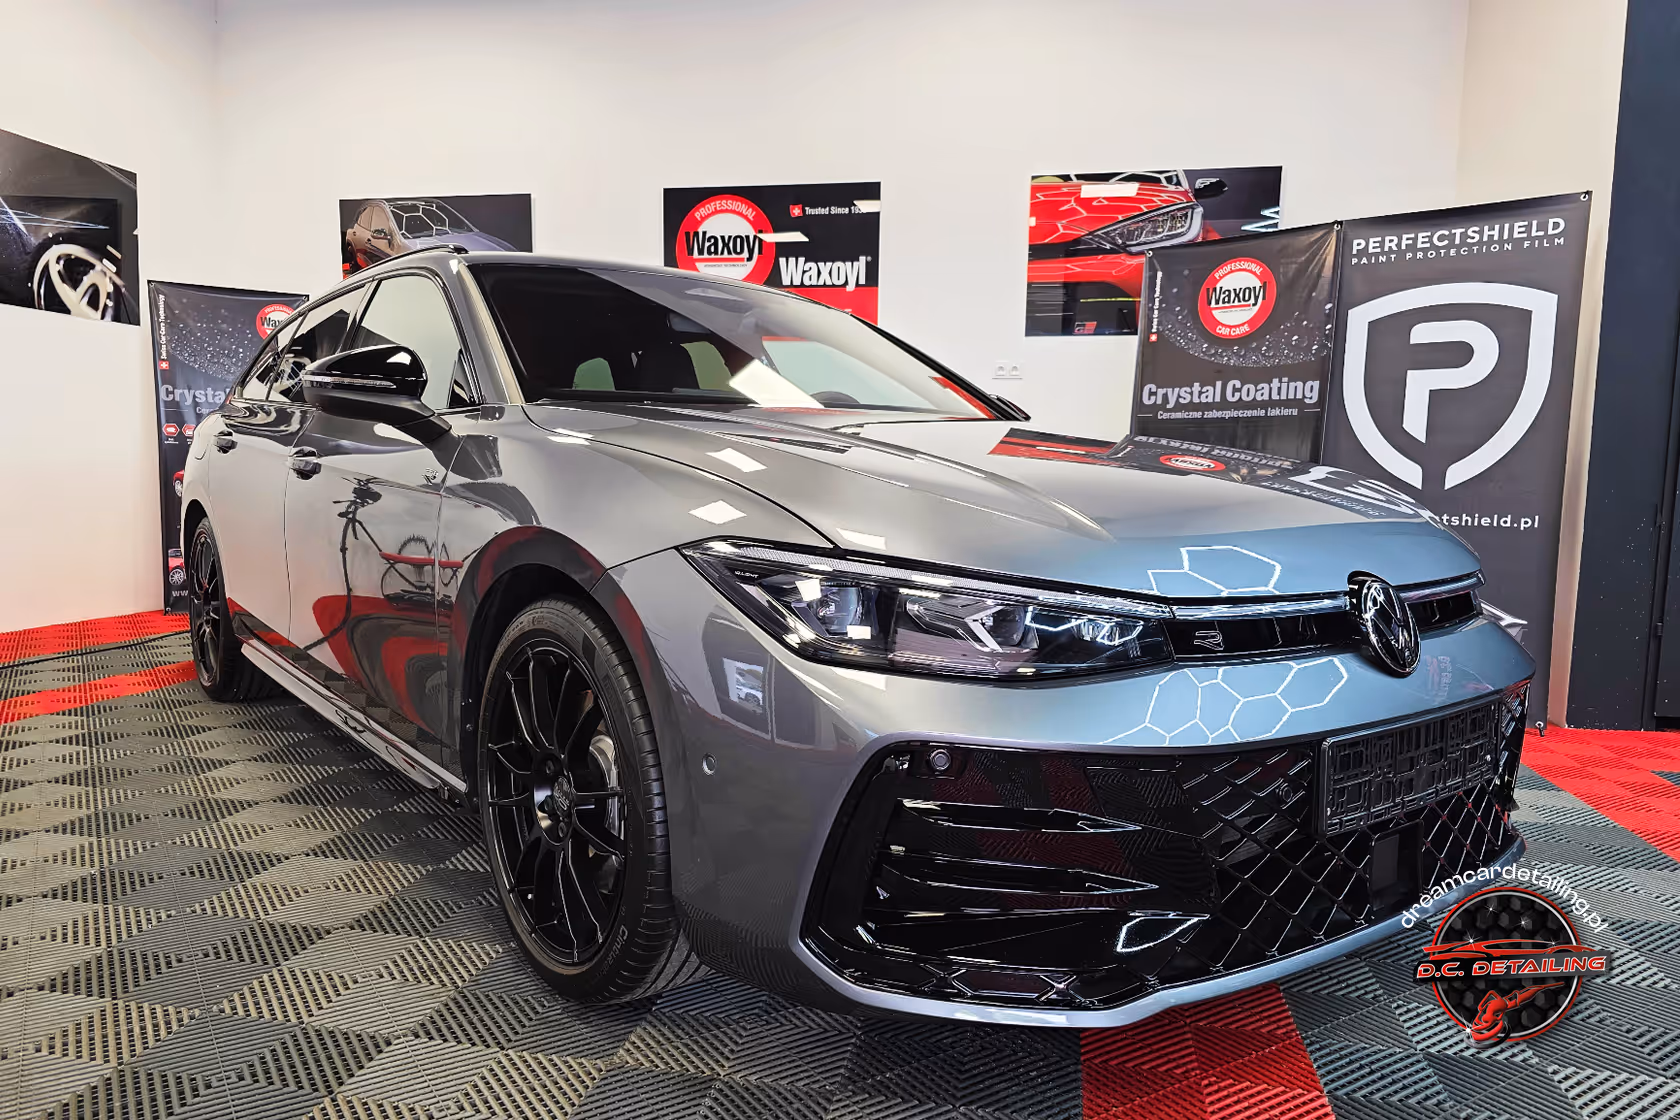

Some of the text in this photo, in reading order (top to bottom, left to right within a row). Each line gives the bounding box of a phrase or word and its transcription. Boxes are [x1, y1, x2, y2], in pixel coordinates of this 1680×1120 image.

[694, 200, 756, 221] PROFESSIONAL
[805, 206, 829, 215] Trusted
[830, 206, 849, 214] Since
[1352, 217, 1566, 254] PERFECTSHIELD
[1351, 237, 1565, 265] PAINT PROTECTION FILM
[1214, 261, 1263, 280] PROFESSIONAL
[1206, 281, 1267, 307] Waxoyl
[1215, 324, 1250, 336] CAR CARE
[1142, 377, 1320, 409] Crystal Coating
[1157, 411, 1202, 420] Ceramiczne
[1203, 409, 1266, 419] zabezpieczenie
[1440, 513, 1540, 531] tshield.pl
